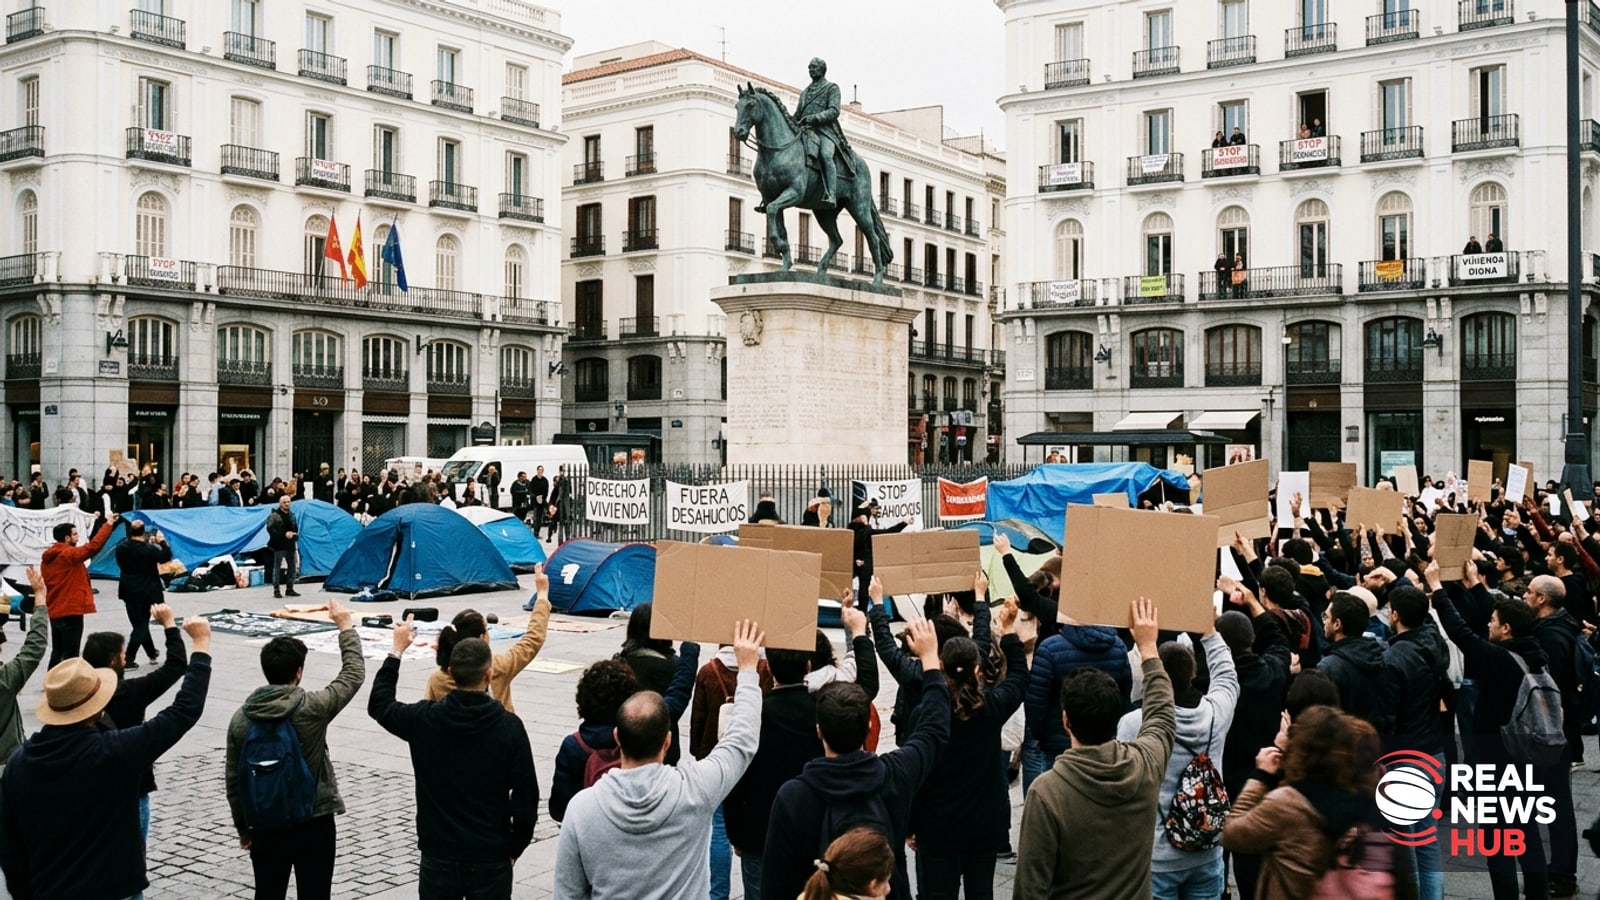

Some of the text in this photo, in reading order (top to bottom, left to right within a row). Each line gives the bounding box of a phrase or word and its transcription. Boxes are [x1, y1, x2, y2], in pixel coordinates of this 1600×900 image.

[1218, 146, 1242, 157] STOP
[1298, 139, 1322, 150] STOP
[588, 480, 648, 498] DERECHO A
[681, 488, 729, 505] FUERA
[878, 484, 907, 500] STOP
[589, 501, 648, 520] VIVIENDA
[672, 504, 745, 524] DESAHUCIOS
